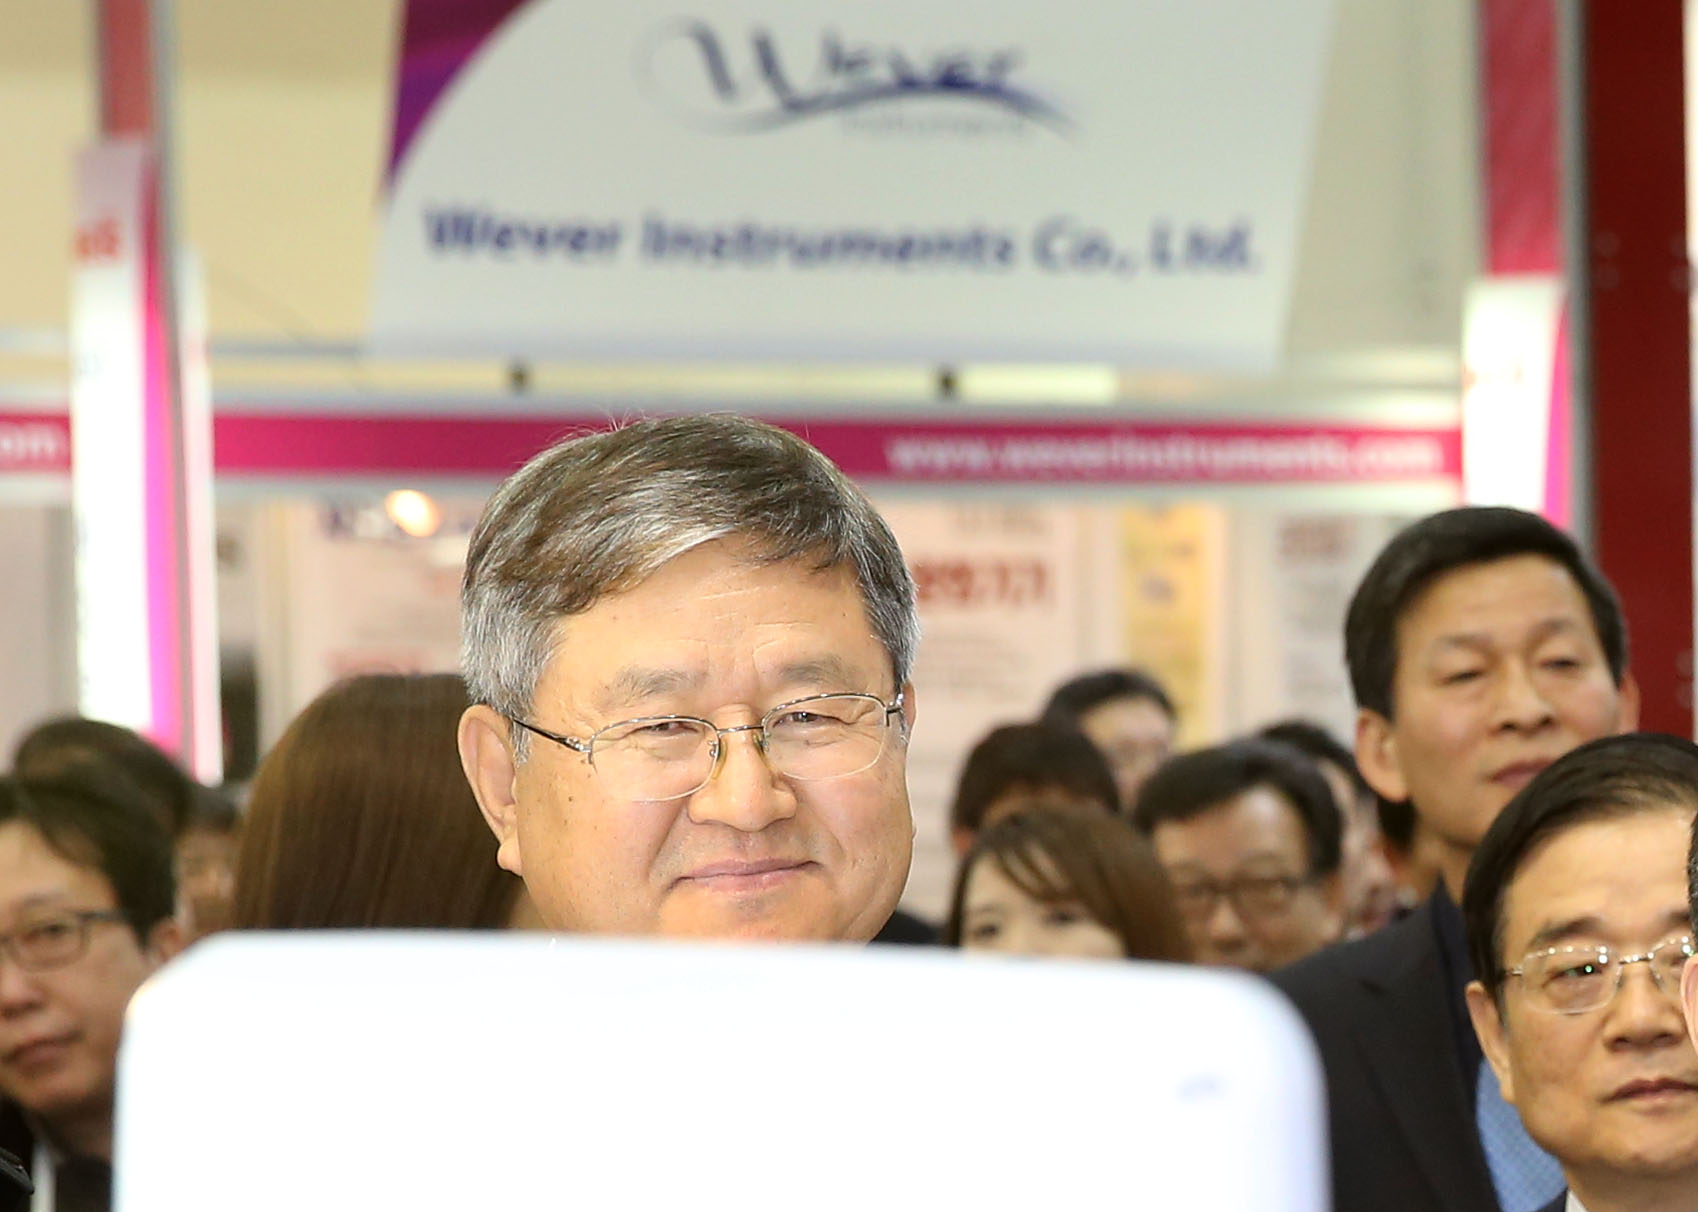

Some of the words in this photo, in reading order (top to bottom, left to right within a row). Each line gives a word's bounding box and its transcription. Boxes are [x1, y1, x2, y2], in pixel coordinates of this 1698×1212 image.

[640, 16, 1078, 136] Wever
[424, 208, 624, 272] Wever
[640, 218, 1018, 272] Instruments
[1032, 218, 1136, 276] Co.,
[1154, 224, 1260, 274] Ltd.
[884, 432, 1442, 474] www.weverinstruments.com
